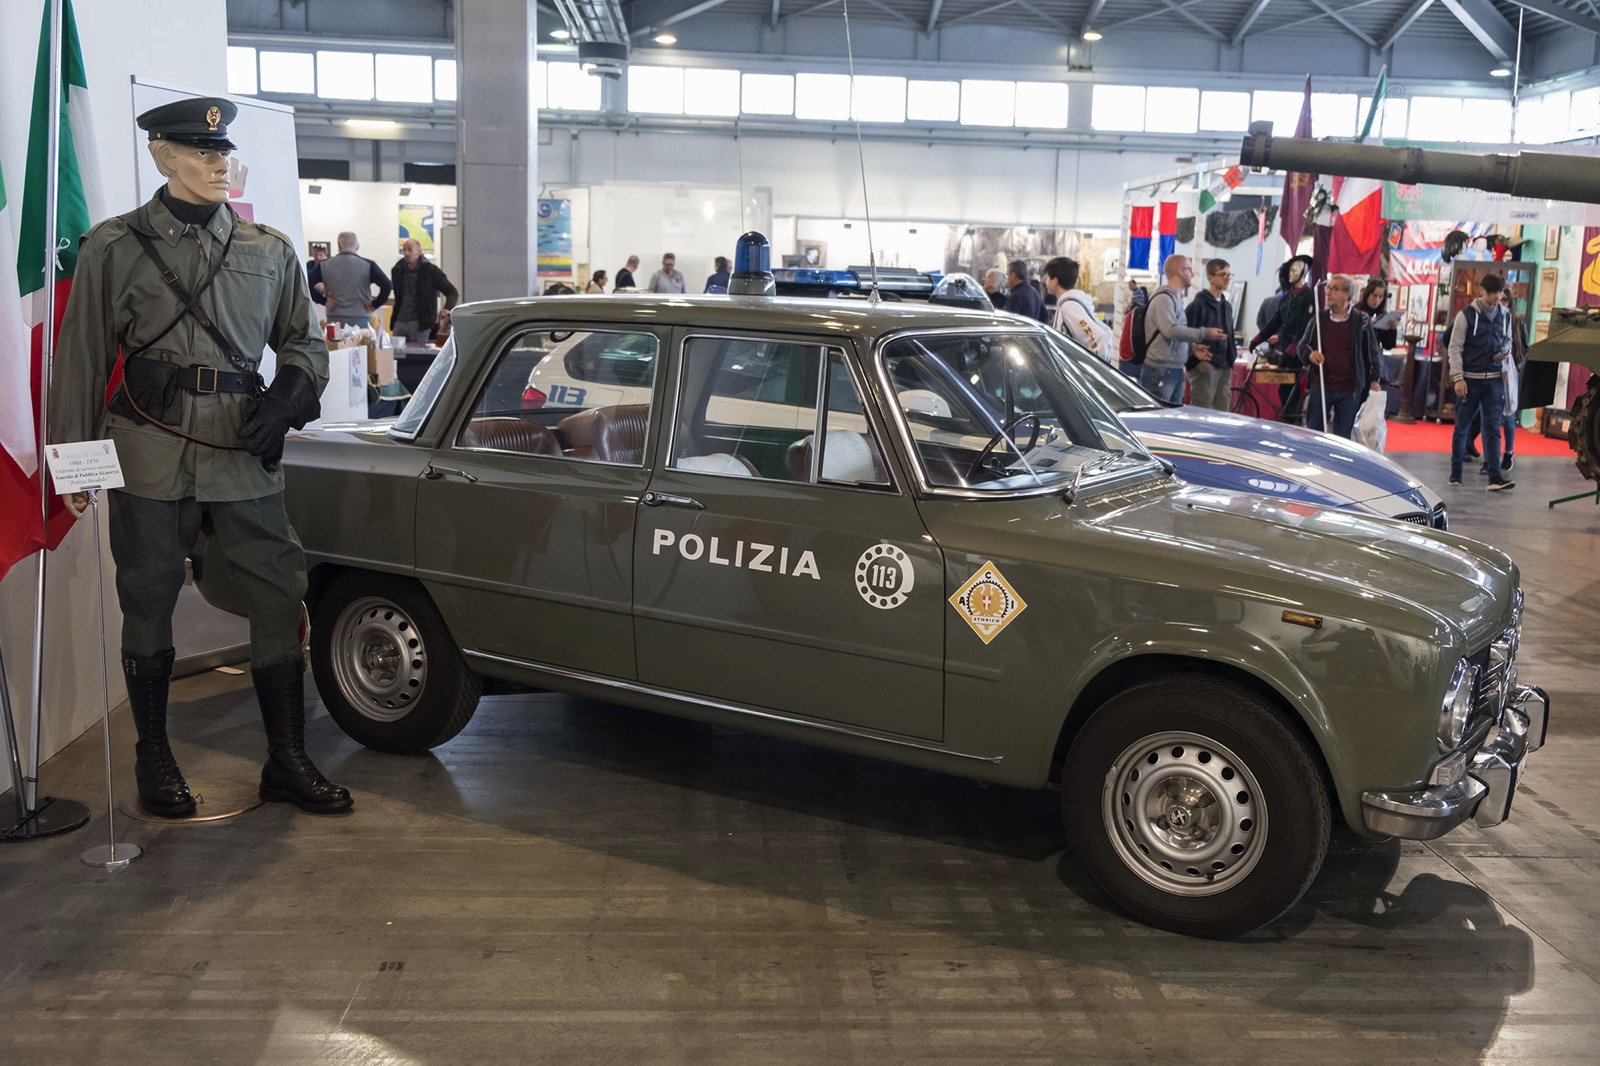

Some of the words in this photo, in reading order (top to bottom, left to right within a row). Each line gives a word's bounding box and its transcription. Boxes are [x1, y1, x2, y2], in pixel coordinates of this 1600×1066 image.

[548, 384, 587, 406] 113
[652, 528, 821, 580] POLIZIA
[872, 564, 897, 589] 113
